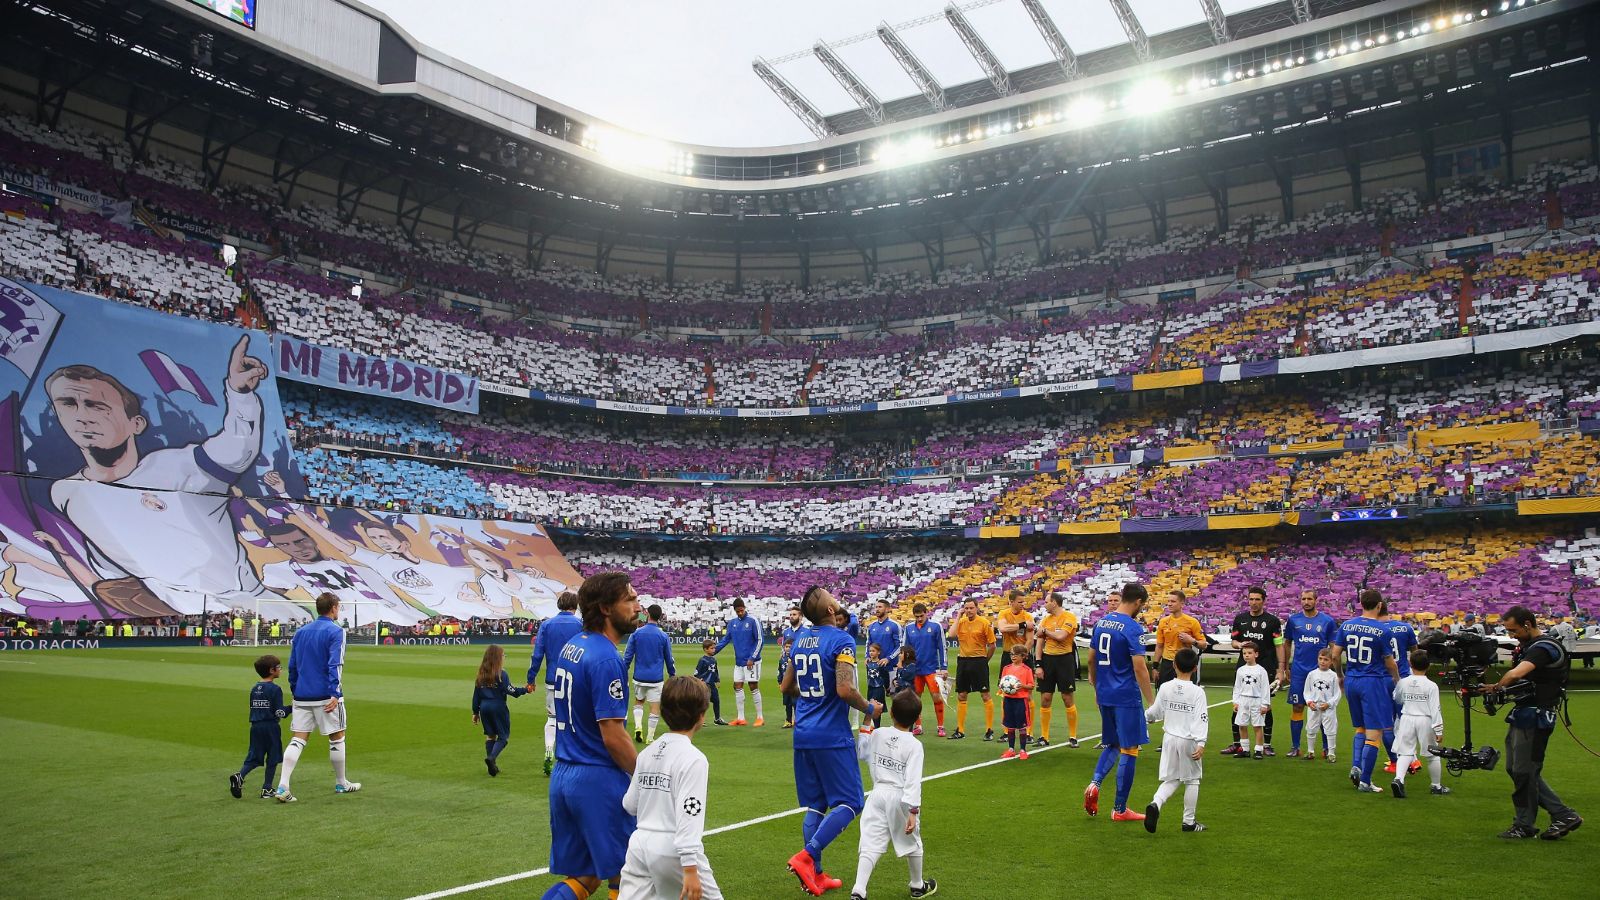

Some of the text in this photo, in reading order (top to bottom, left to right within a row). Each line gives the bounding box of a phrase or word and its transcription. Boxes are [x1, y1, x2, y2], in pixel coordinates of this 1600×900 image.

[280, 339, 476, 406] MI MADRID!
[492, 383, 514, 394] Madrid
[1054, 383, 1078, 391] Madrid
[545, 393, 580, 404] Real Madrid
[979, 391, 1002, 399] Madrid
[613, 403, 650, 413] Real Madrid
[840, 404, 861, 412] Madrid
[908, 398, 930, 407] Madrid
[675, 636, 686, 644] TO
[1243, 630, 1264, 640] Jeep
[1298, 634, 1320, 644] Jeep
[12, 639, 34, 650] TO
[40, 639, 99, 649] RACISM
[400, 637, 470, 646] NO TO RACISM
[798, 636, 820, 649] VIDAL
[560, 642, 585, 664] PIRLO
[1098, 632, 1111, 666] 9
[1346, 634, 1374, 664] 26
[750, 671, 755, 679] 2
[794, 653, 825, 698] 23
[554, 667, 576, 733] 21
[1292, 693, 1299, 704] 3
[1169, 702, 1195, 712] RESPECT
[877, 756, 907, 772] RESPECT
